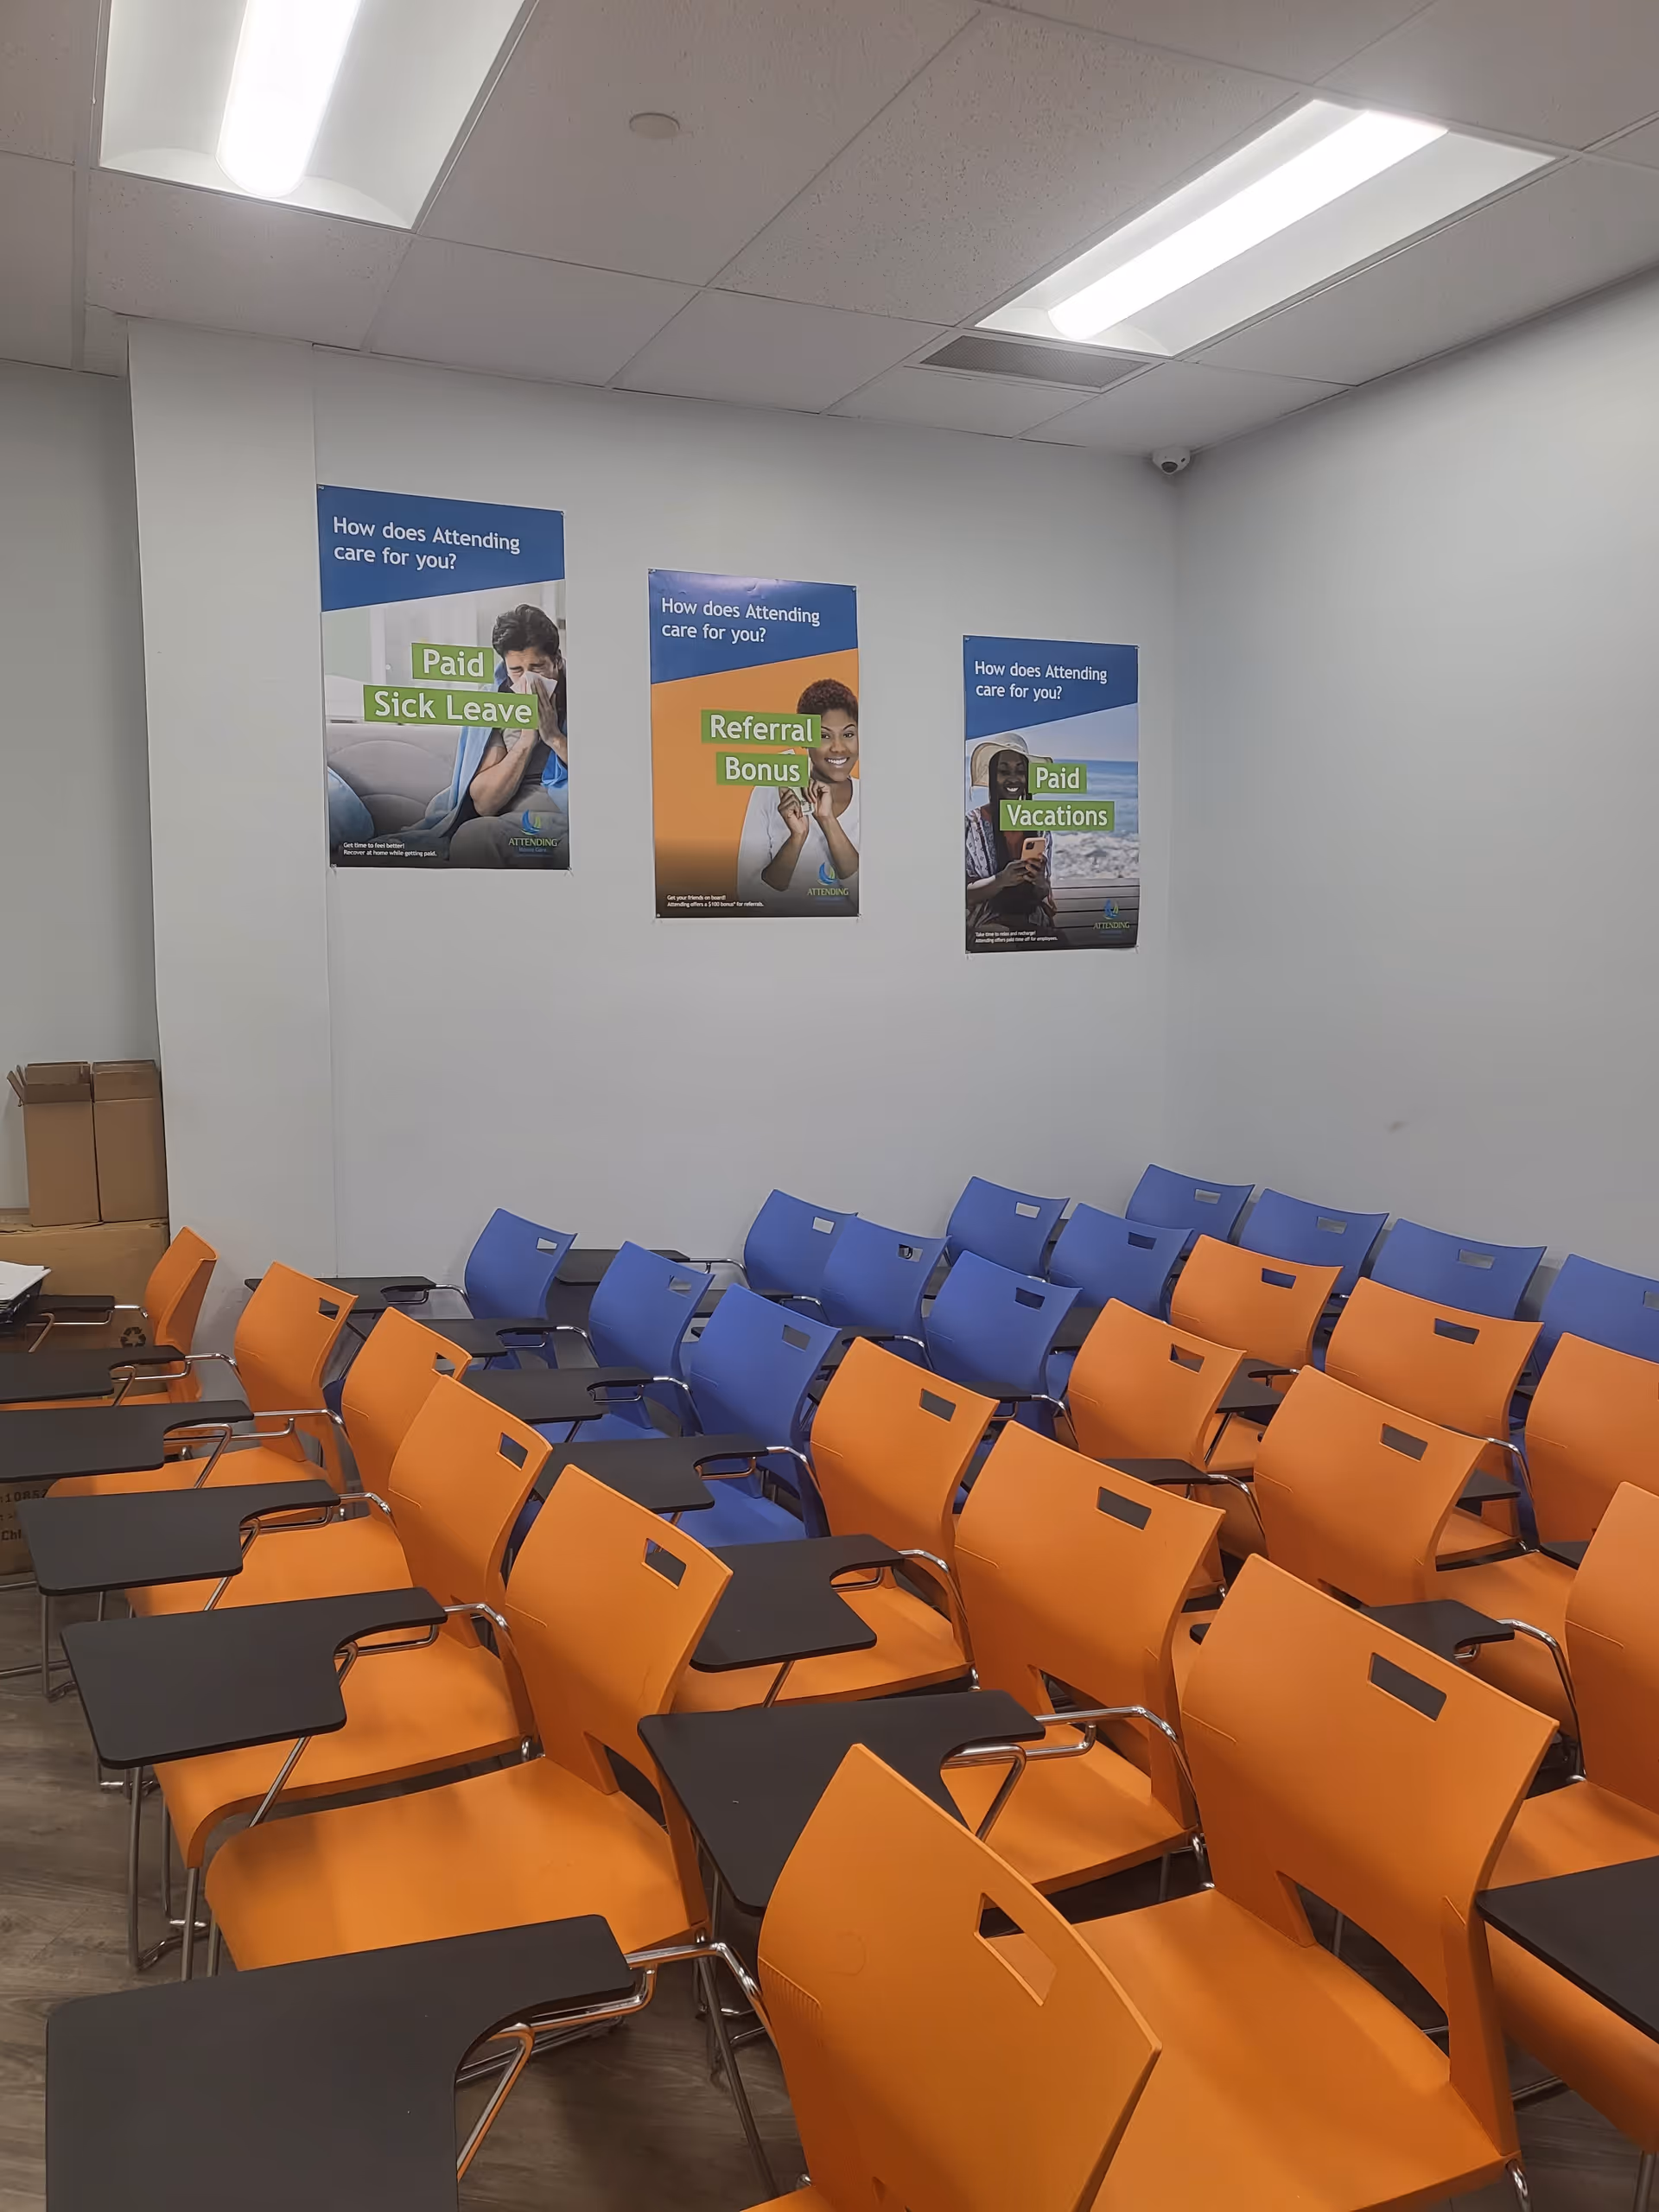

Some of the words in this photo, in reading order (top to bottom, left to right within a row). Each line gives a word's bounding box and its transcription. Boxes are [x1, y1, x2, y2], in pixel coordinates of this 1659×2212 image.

[334, 516, 375, 537] How
[383, 521, 426, 543] does
[433, 526, 520, 554] Attending
[334, 545, 376, 563] care
[382, 547, 409, 565] for
[416, 551, 457, 571] you?
[662, 598, 697, 615] How
[703, 601, 740, 618] does
[746, 603, 820, 626] Attending
[662, 624, 696, 639] care
[702, 625, 725, 640] for
[731, 627, 766, 645] you?
[423, 649, 484, 677] Paid
[975, 661, 1006, 677] How
[1010, 663, 1041, 678] does
[1045, 664, 1108, 684] Attending
[976, 684, 1005, 698] care
[1009, 684, 1028, 699] for
[1033, 687, 1063, 702] you?
[374, 690, 436, 720] Sick
[447, 696, 532, 724] Leave
[710, 715, 812, 742] Referral
[725, 756, 800, 782] Bonus
[1036, 767, 1080, 789] Paid
[1007, 804, 1109, 826] Vacations
[508, 837, 557, 847] ATTENDING
[806, 887, 849, 896] ATTENDING
[1092, 921, 1130, 930] ATTENDING
